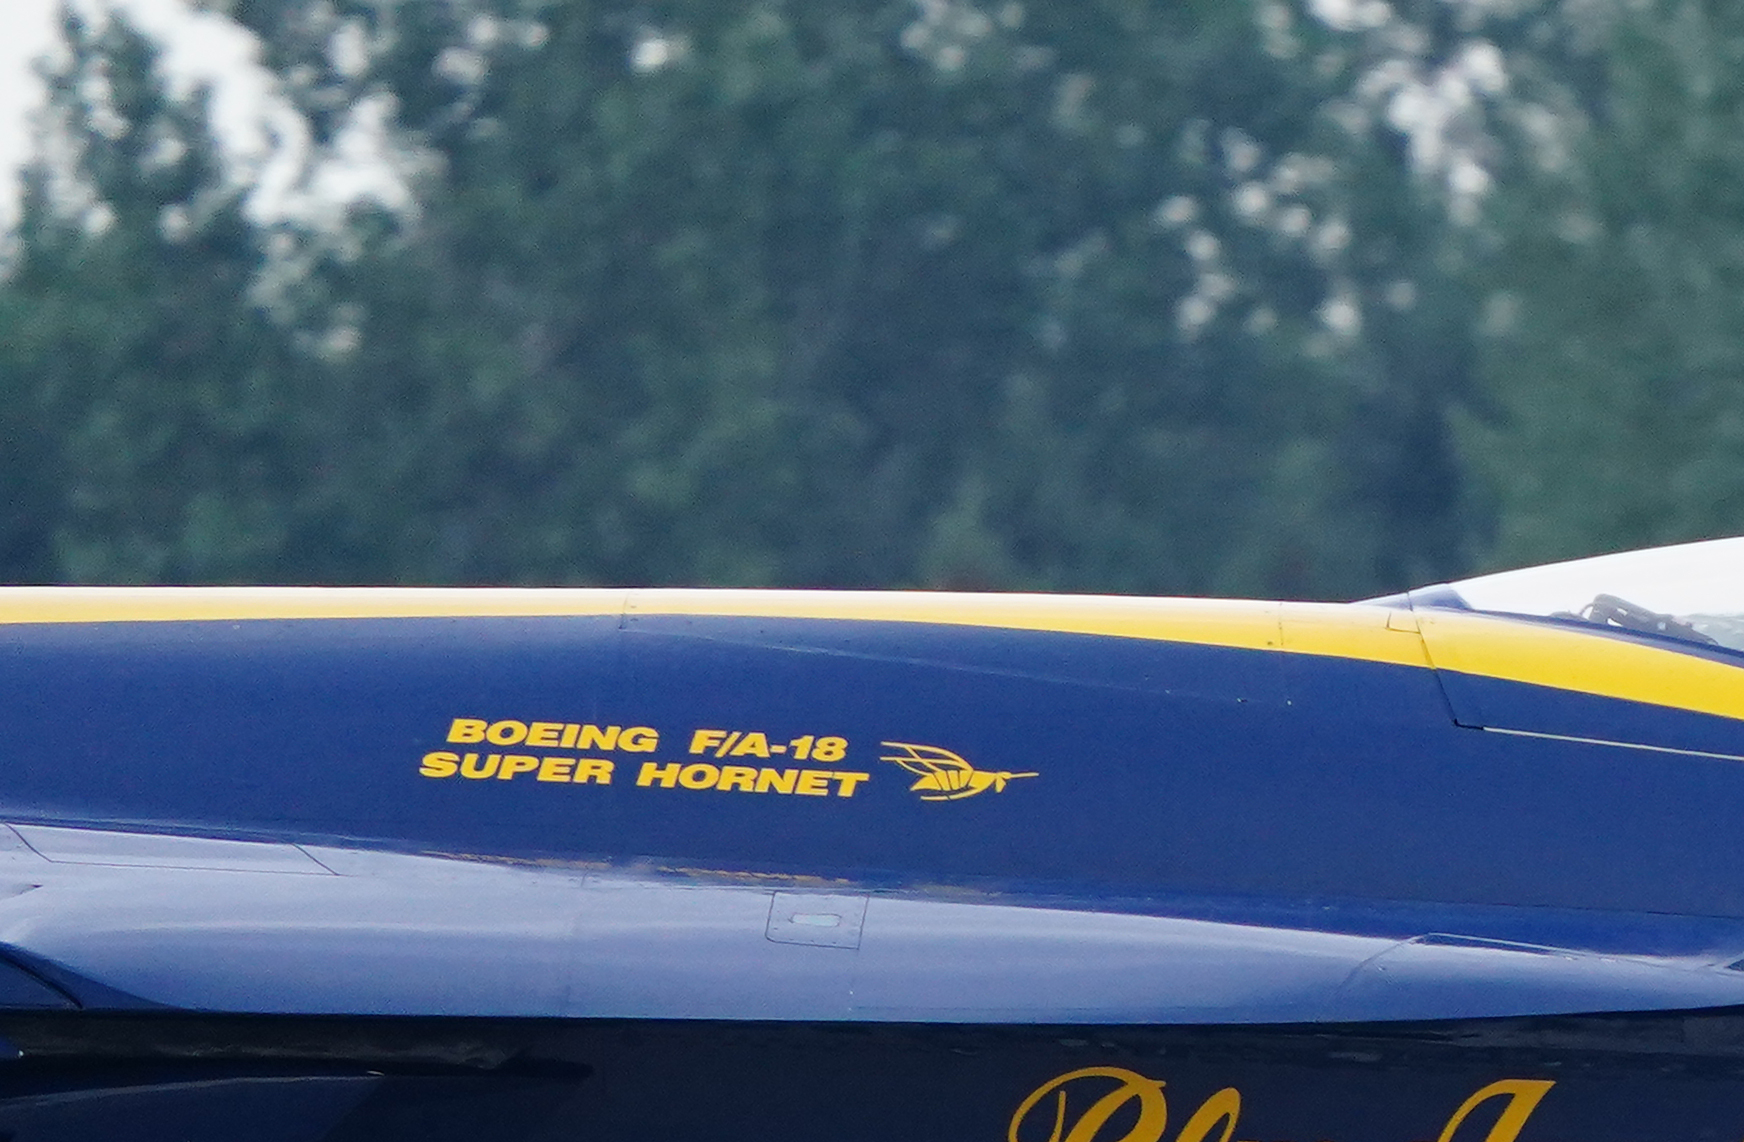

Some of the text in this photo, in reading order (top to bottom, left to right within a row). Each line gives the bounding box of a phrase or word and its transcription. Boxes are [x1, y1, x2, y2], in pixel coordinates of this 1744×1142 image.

[447, 719, 848, 763] BOEING F/A-18
[419, 752, 870, 798] SUPER HORNET
